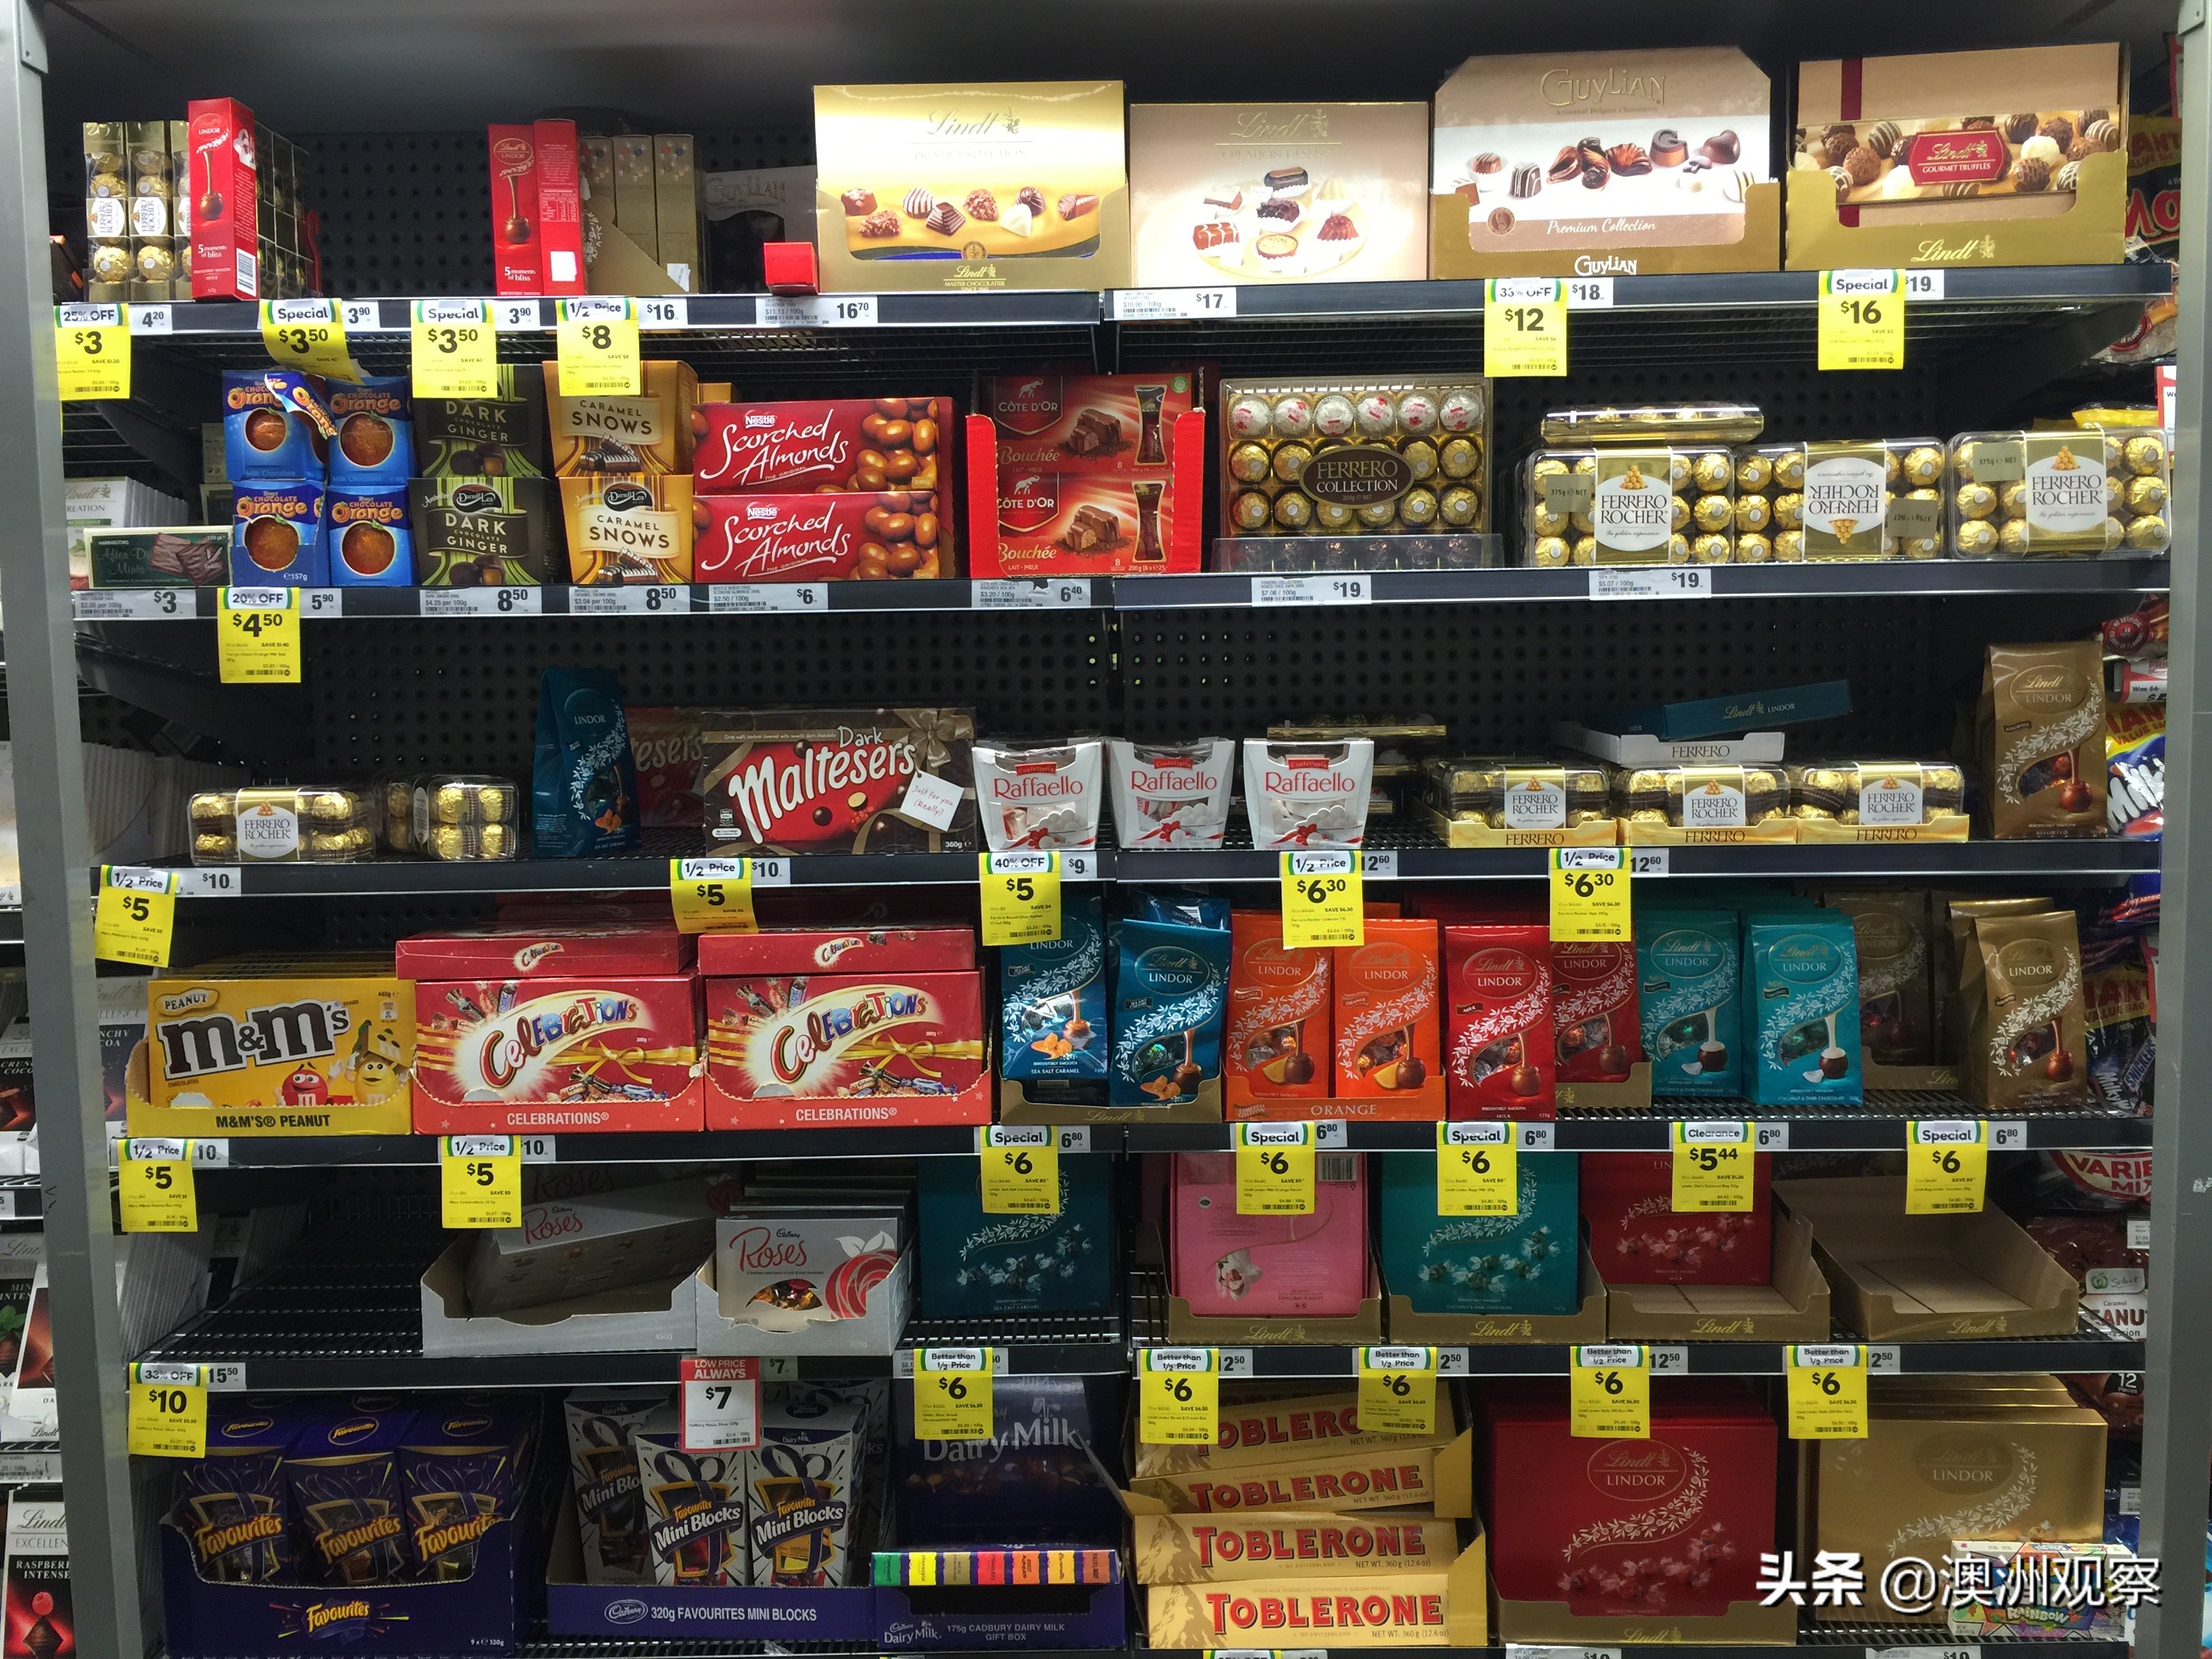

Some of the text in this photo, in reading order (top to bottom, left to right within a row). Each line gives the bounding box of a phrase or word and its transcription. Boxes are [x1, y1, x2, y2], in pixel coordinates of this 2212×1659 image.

[1590, 106, 1616, 116] Belgian
[1618, 106, 1658, 114] Chocolates
[1922, 163, 1991, 173] GOURMET TRUFFLES
[1547, 219, 1656, 235] Premium Collection
[1910, 241, 1978, 263] Lindt
[1572, 284, 1600, 300] $18
[1195, 293, 1223, 310] $17
[63, 310, 115, 321] 25% OFF
[789, 308, 804, 316] 100g
[1504, 308, 1544, 331] $12
[1840, 300, 1881, 325] $16
[75, 331, 102, 354] $3
[582, 325, 612, 350] $8
[330, 396, 401, 414] Orange
[579, 399, 642, 417] CARAMEL
[998, 401, 1058, 411] CÔTE D'OR
[571, 411, 653, 435] SNOWS
[1316, 459, 1398, 479] FERRERO
[1316, 479, 1398, 493] COLLECTION
[445, 514, 507, 535] DARK
[701, 501, 836, 571] Scorched
[447, 536, 508, 554] GINGER
[734, 524, 851, 577] Almonds
[1671, 572, 1700, 588] $19
[1333, 582, 1361, 598] $19
[232, 593, 283, 604] 20% OFF
[1723, 702, 1795, 721] Lindt LINDOR
[838, 726, 884, 747] Dark
[1672, 744, 1729, 758] FERRERO
[994, 775, 1083, 800] Raffaello
[1131, 771, 1218, 792] Raffaello
[1264, 772, 1355, 794] Raffaello
[729, 742, 916, 844] Maltesers
[1512, 804, 1558, 814] ROCHER
[245, 829, 291, 839] ROCHER
[1856, 827, 1917, 840] FERRERO
[945, 840, 963, 849] 360g
[684, 862, 735, 877] 1/2 Price
[1069, 859, 1085, 874] $9
[202, 873, 230, 890] $10
[1006, 877, 1033, 902] $5
[1149, 972, 1193, 983] LINDOR
[164, 993, 207, 1010] PEANUT
[1311, 1105, 1377, 1115] ORANGE
[280, 1115, 330, 1128] PEANUT
[995, 1132, 1043, 1145] Special
[1688, 1128, 1740, 1139] Clearance
[1923, 1130, 1972, 1143] Special
[1261, 1151, 1289, 1174] $6
[1462, 1151, 1490, 1174] $6
[145, 1166, 172, 1189] $5
[466, 1162, 494, 1186] $5
[523, 1208, 583, 1245] Roses
[2112, 1277, 2139, 1288] Select
[1691, 1319, 1742, 1334] Lindt
[718, 1359, 745, 1368] PRICE
[170, 1370, 194, 1381] OFF
[694, 1368, 746, 1379] ALWAYS
[2118, 1373, 2137, 1388] 12
[1811, 1372, 1841, 1395] $6
[149, 1389, 187, 1414] $10
[705, 1386, 733, 1410] $7
[1607, 1475, 1666, 1486] LINDOR
[1933, 1469, 1994, 1482] LINDOR
[655, 1507, 741, 1550] Mini Blocks
[194, 1515, 283, 1563] Favourites
[1193, 1525, 1426, 1568] TOBLERONE
[24, 1571, 70, 1579] INTENSE
[306, 1601, 370, 1633] Favourites
[609, 1604, 644, 1620] Cadbury
[651, 1607, 817, 1622] 320g FAVOURITES MINI BLOCKS
[1206, 1593, 1443, 1635] TOBLERONE
[947, 1624, 966, 1634] 175g
[968, 1624, 1012, 1633] CADBURY
[985, 1633, 1006, 1641] GIFT
